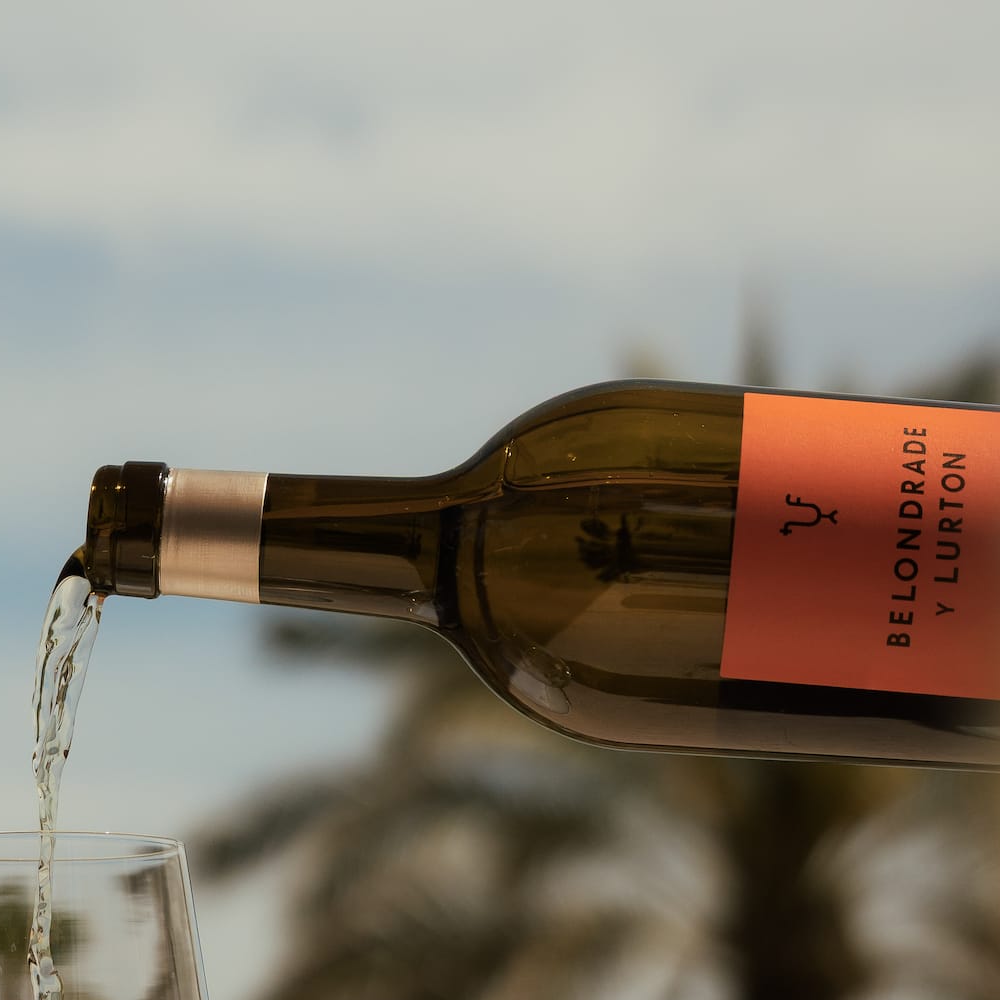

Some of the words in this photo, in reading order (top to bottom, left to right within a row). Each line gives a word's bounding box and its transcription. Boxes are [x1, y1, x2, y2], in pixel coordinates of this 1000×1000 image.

[886, 427, 927, 648] BELONDRADE
[934, 452, 966, 584] LURTON
[935, 601, 955, 616] Y
